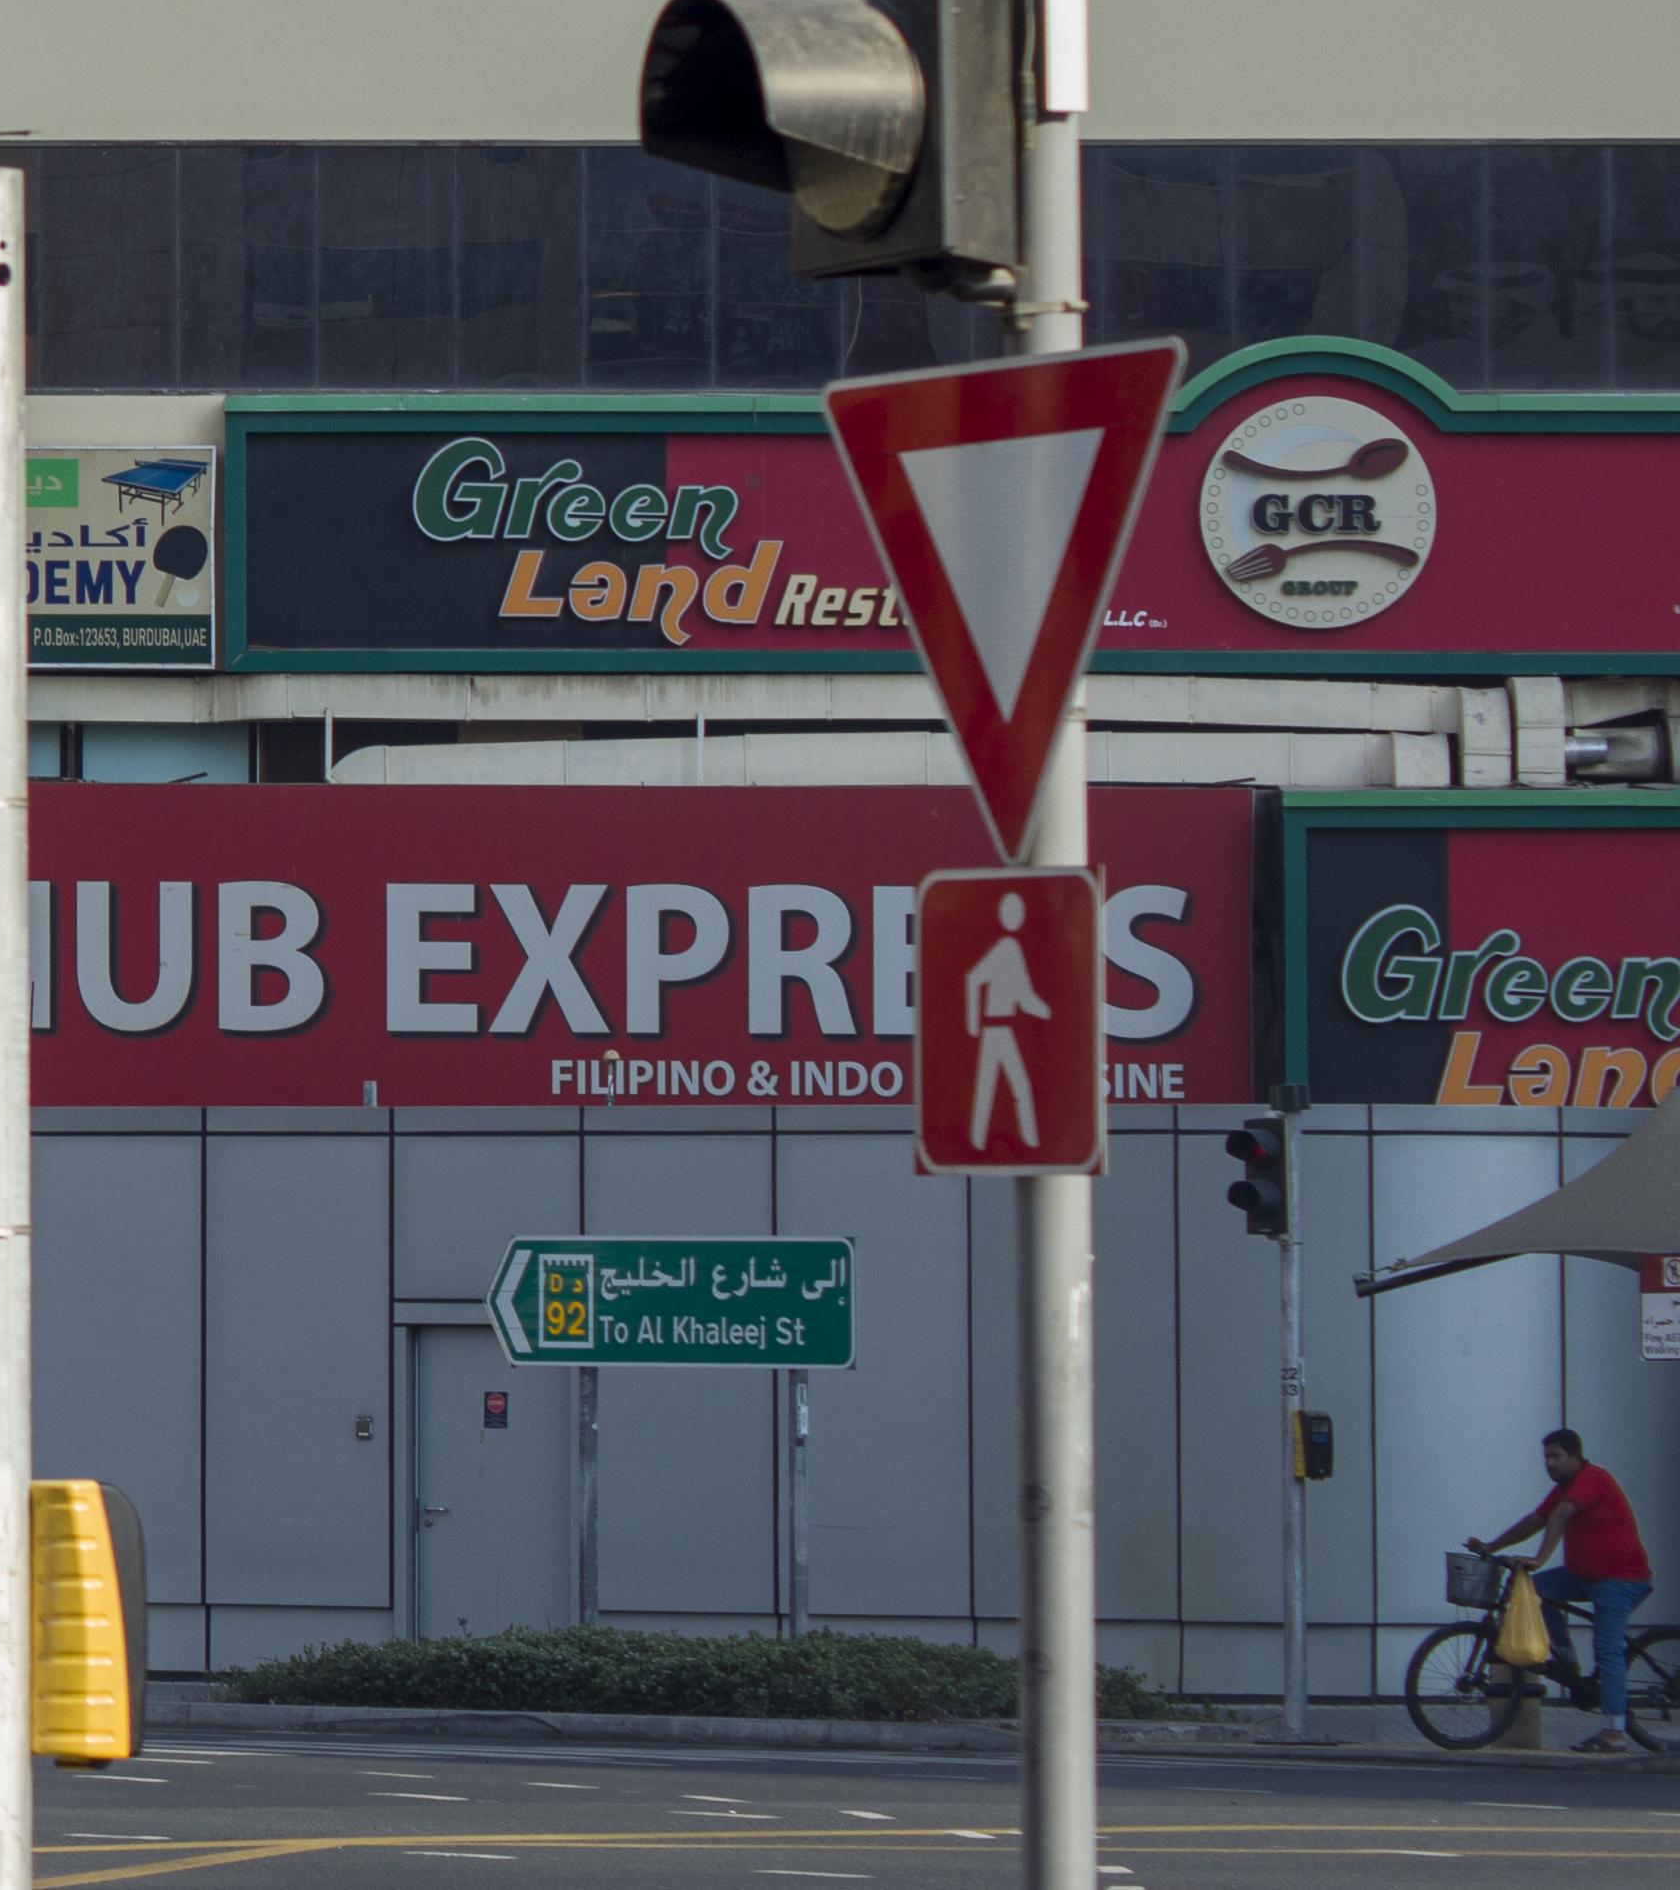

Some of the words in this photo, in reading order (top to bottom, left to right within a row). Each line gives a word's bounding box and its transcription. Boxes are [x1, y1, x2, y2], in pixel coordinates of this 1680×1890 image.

[412, 436, 739, 561] Green
[1252, 494, 1381, 535] GCR
[499, 540, 784, 647] Land
[1281, 580, 1358, 597] GROUP
[1341, 904, 1680, 1041] Green
[551, 1059, 736, 1099] FILIPINO
[747, 1060, 779, 1098] &
[1436, 1031, 1680, 1108] Lan
[549, 1273, 563, 1294] D
[600, 1256, 696, 1301] الخليج
[711, 1257, 787, 1300] شارع
[802, 1257, 847, 1306] إلى
[546, 1301, 587, 1337] 92
[599, 1316, 629, 1345] To
[636, 1316, 664, 1345] Al
[672, 1316, 767, 1351] Khaleej
[775, 1317, 806, 1346] St
